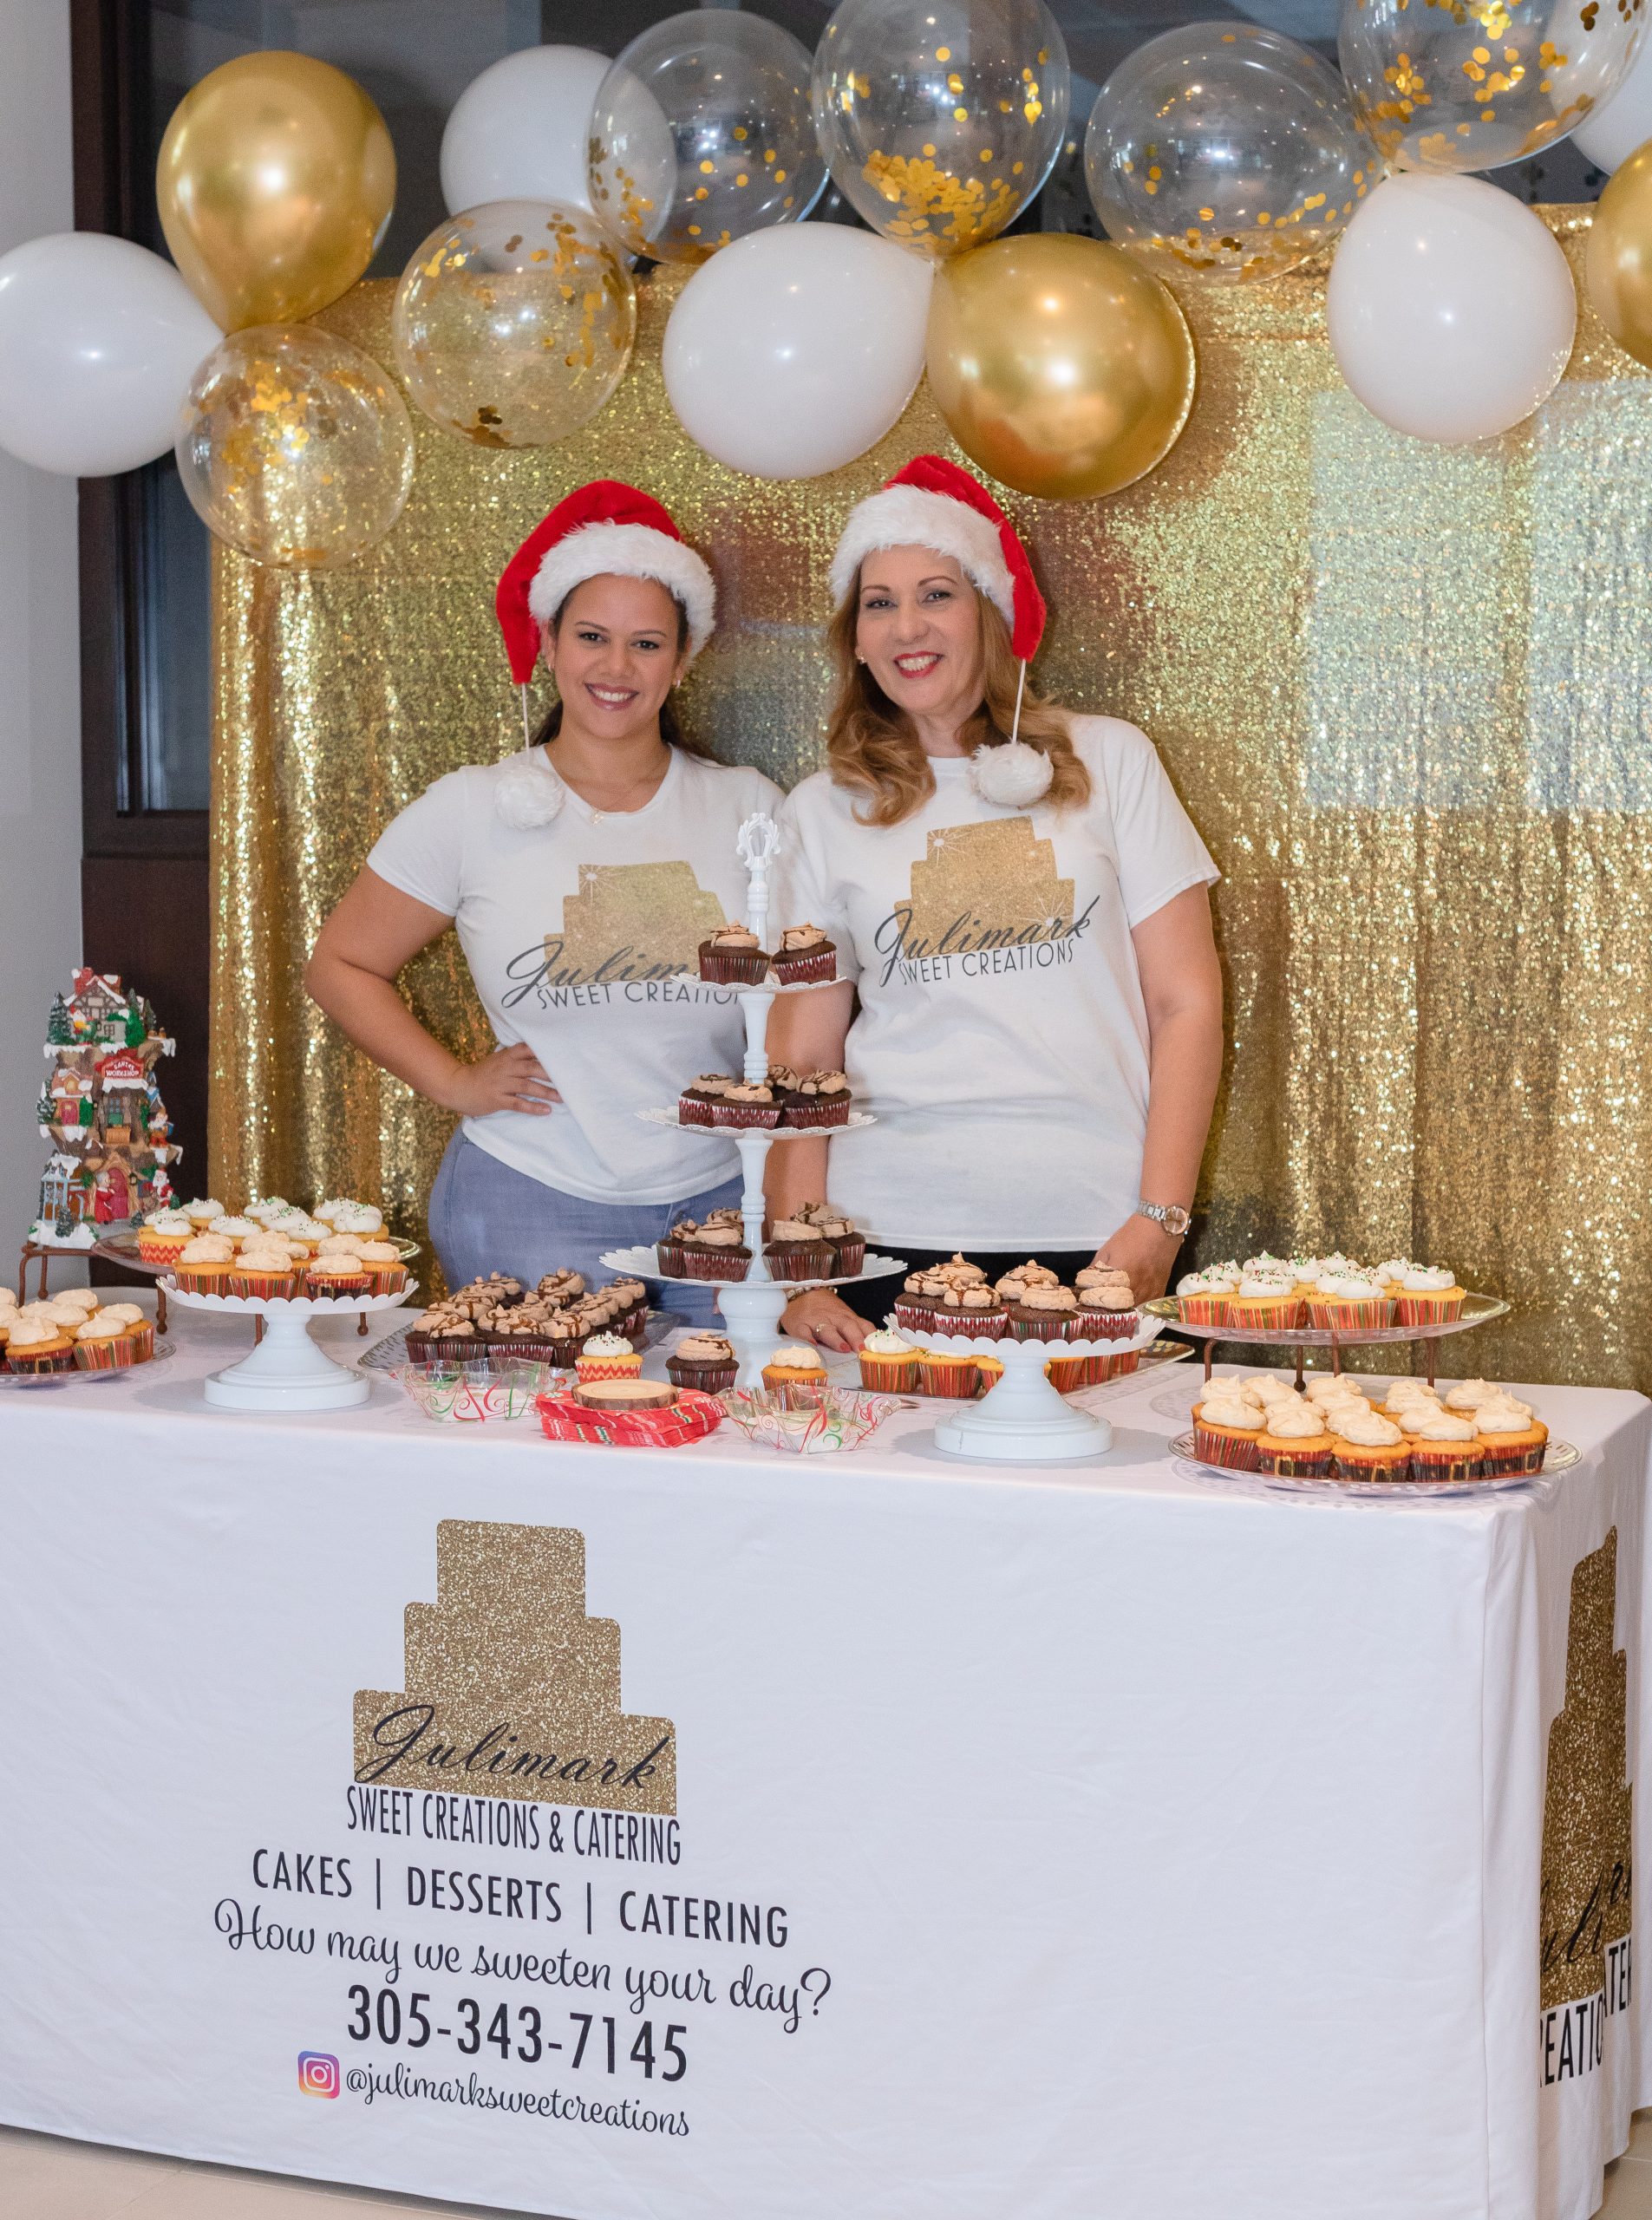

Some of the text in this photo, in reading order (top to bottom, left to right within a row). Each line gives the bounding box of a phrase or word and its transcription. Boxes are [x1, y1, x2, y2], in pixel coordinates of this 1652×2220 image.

[501, 941, 700, 1009] Julim
[874, 895, 1100, 987] Julimark
[898, 938, 1074, 985] SWEET CREATIONS
[538, 983, 611, 1009] SWEET
[353, 1704, 670, 1789] Julimark
[346, 1785, 682, 1865] SWEET CREATIONS & CATERING
[252, 1849, 352, 1898] CAKES
[408, 1865, 562, 1923] DESSERTS
[619, 1890, 788, 1948] CATERING
[214, 1898, 833, 2034] How may we sweeten your day?
[347, 1984, 688, 2083] 305-343-7145
[347, 2062, 690, 2137] @julimarksweetcreations
